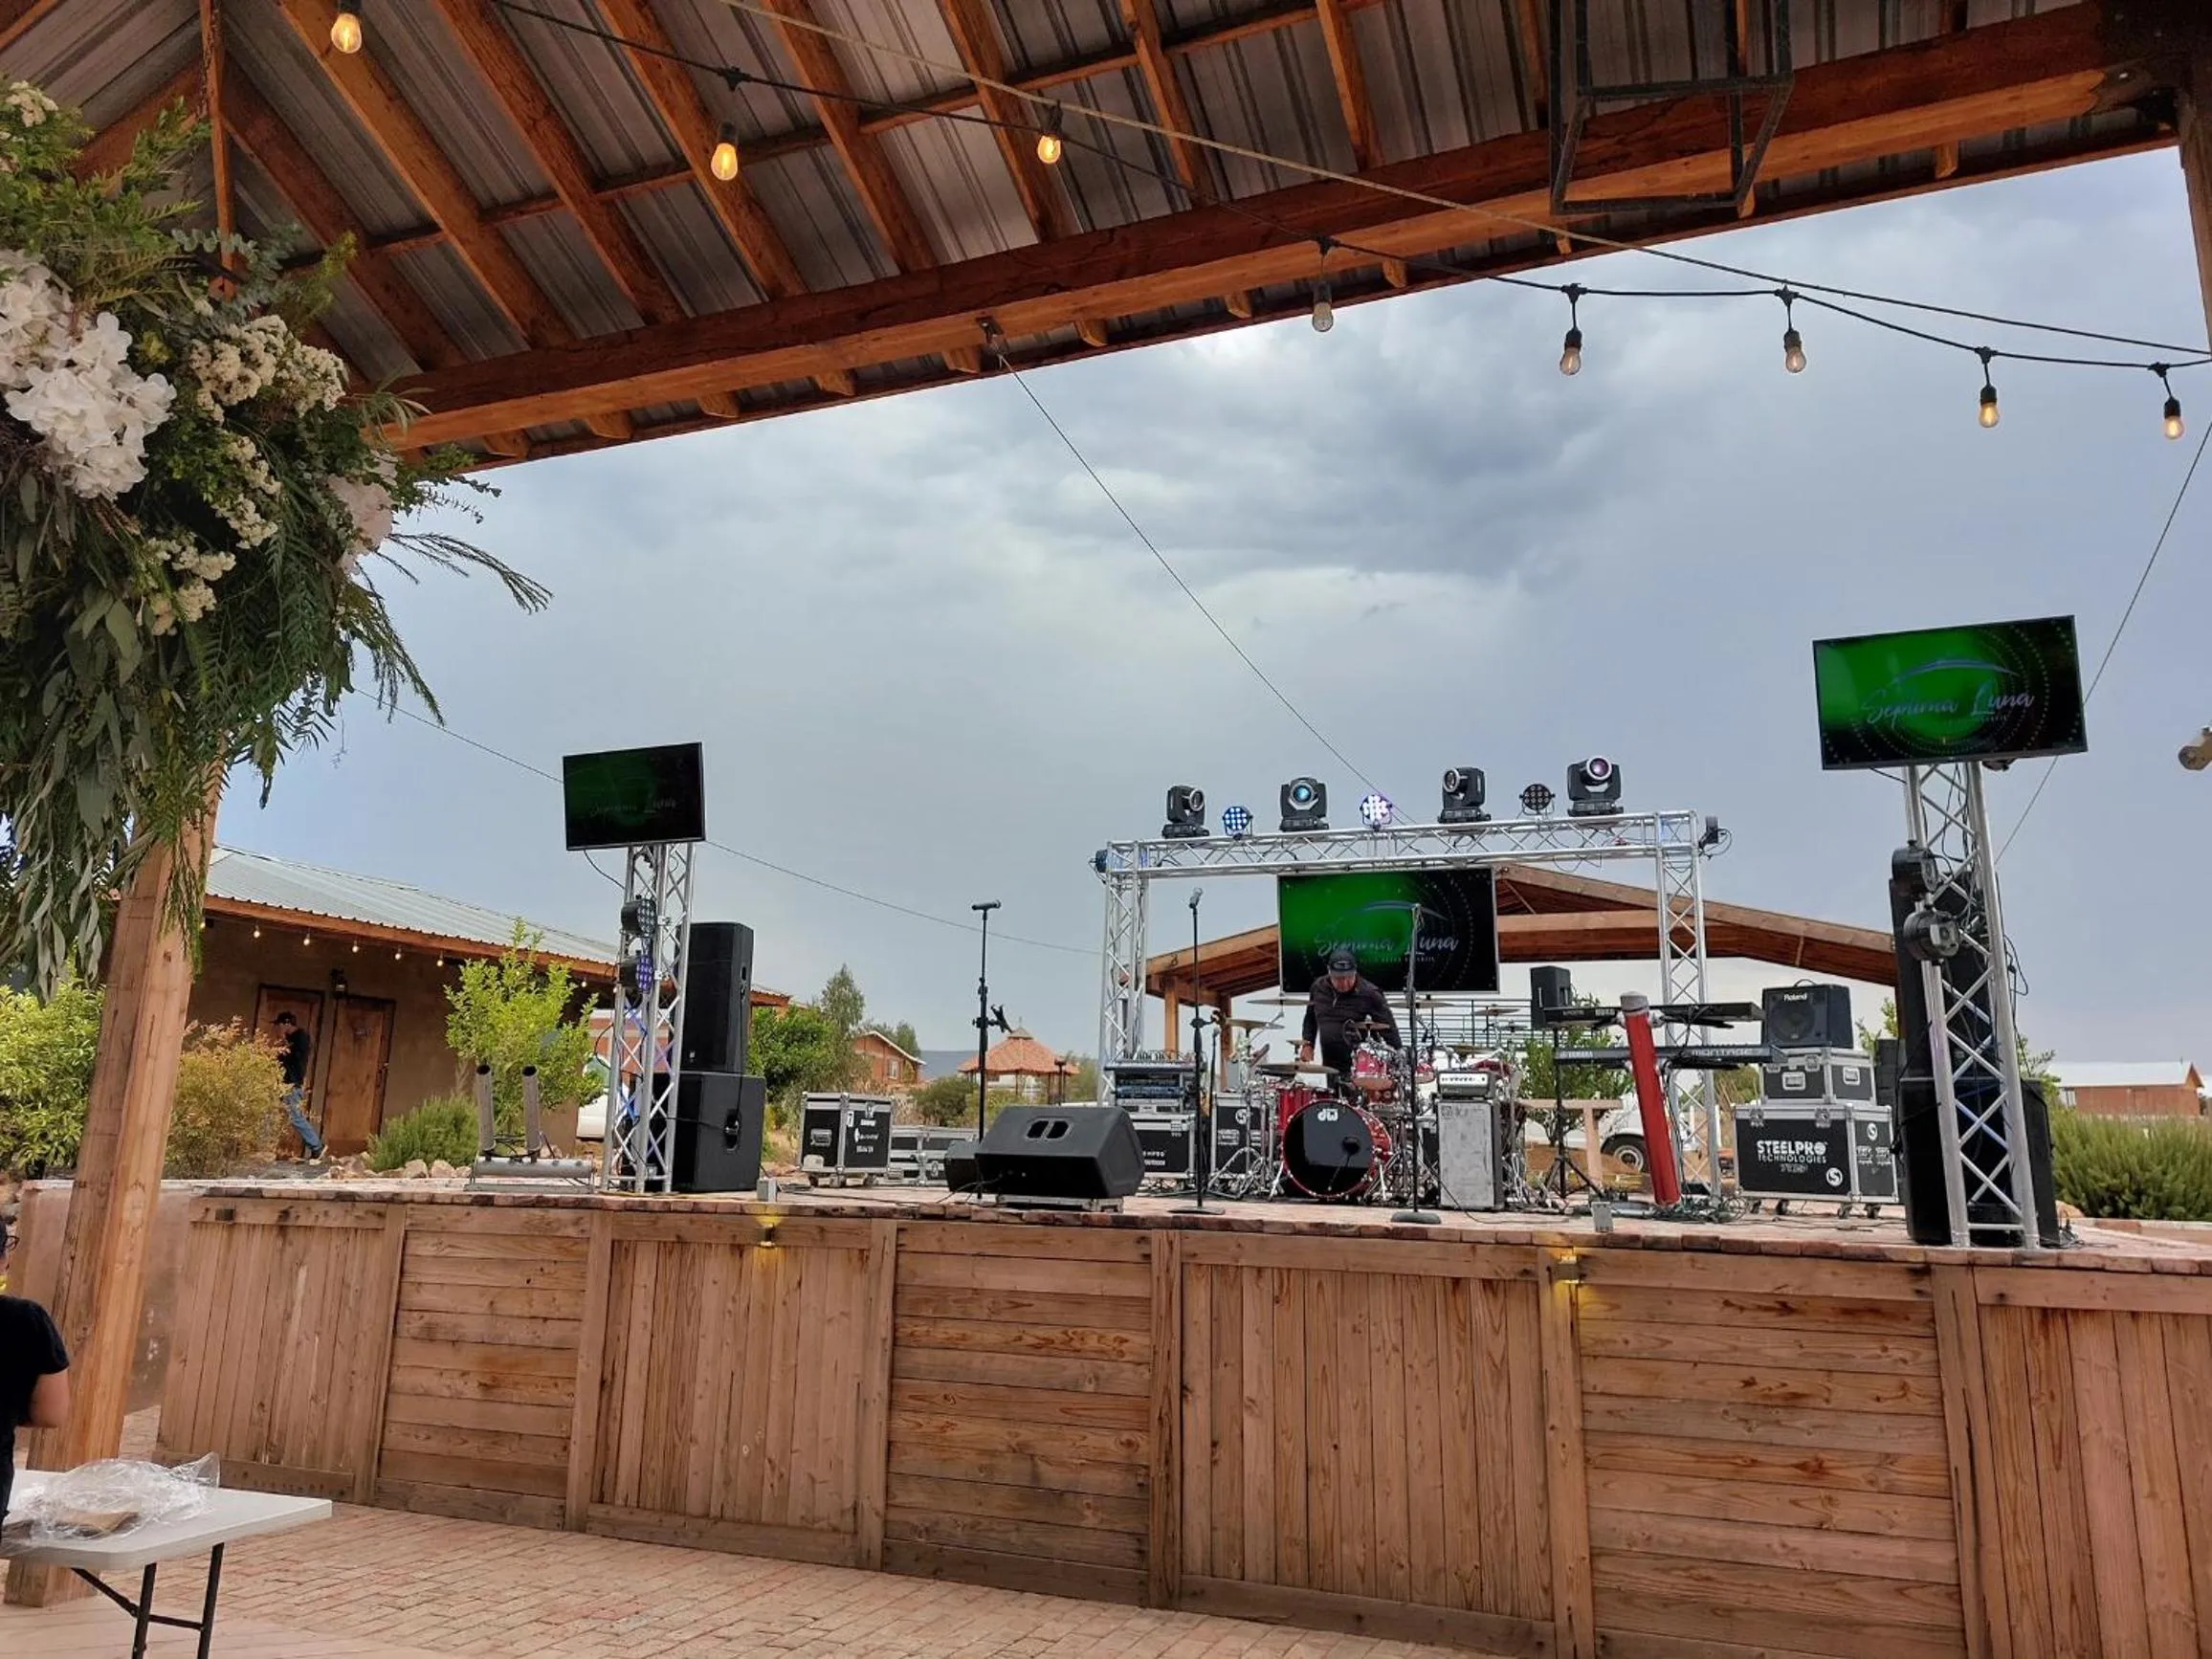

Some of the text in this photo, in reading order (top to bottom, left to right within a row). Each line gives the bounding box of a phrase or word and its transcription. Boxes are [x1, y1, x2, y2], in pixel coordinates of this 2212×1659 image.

[1970, 679, 2036, 717] Luna
[1783, 992, 1807, 1002] Roland
[1757, 1139, 1826, 1156] STEELPRO
[1758, 1154, 1826, 1164] TECHNOLOGIES
